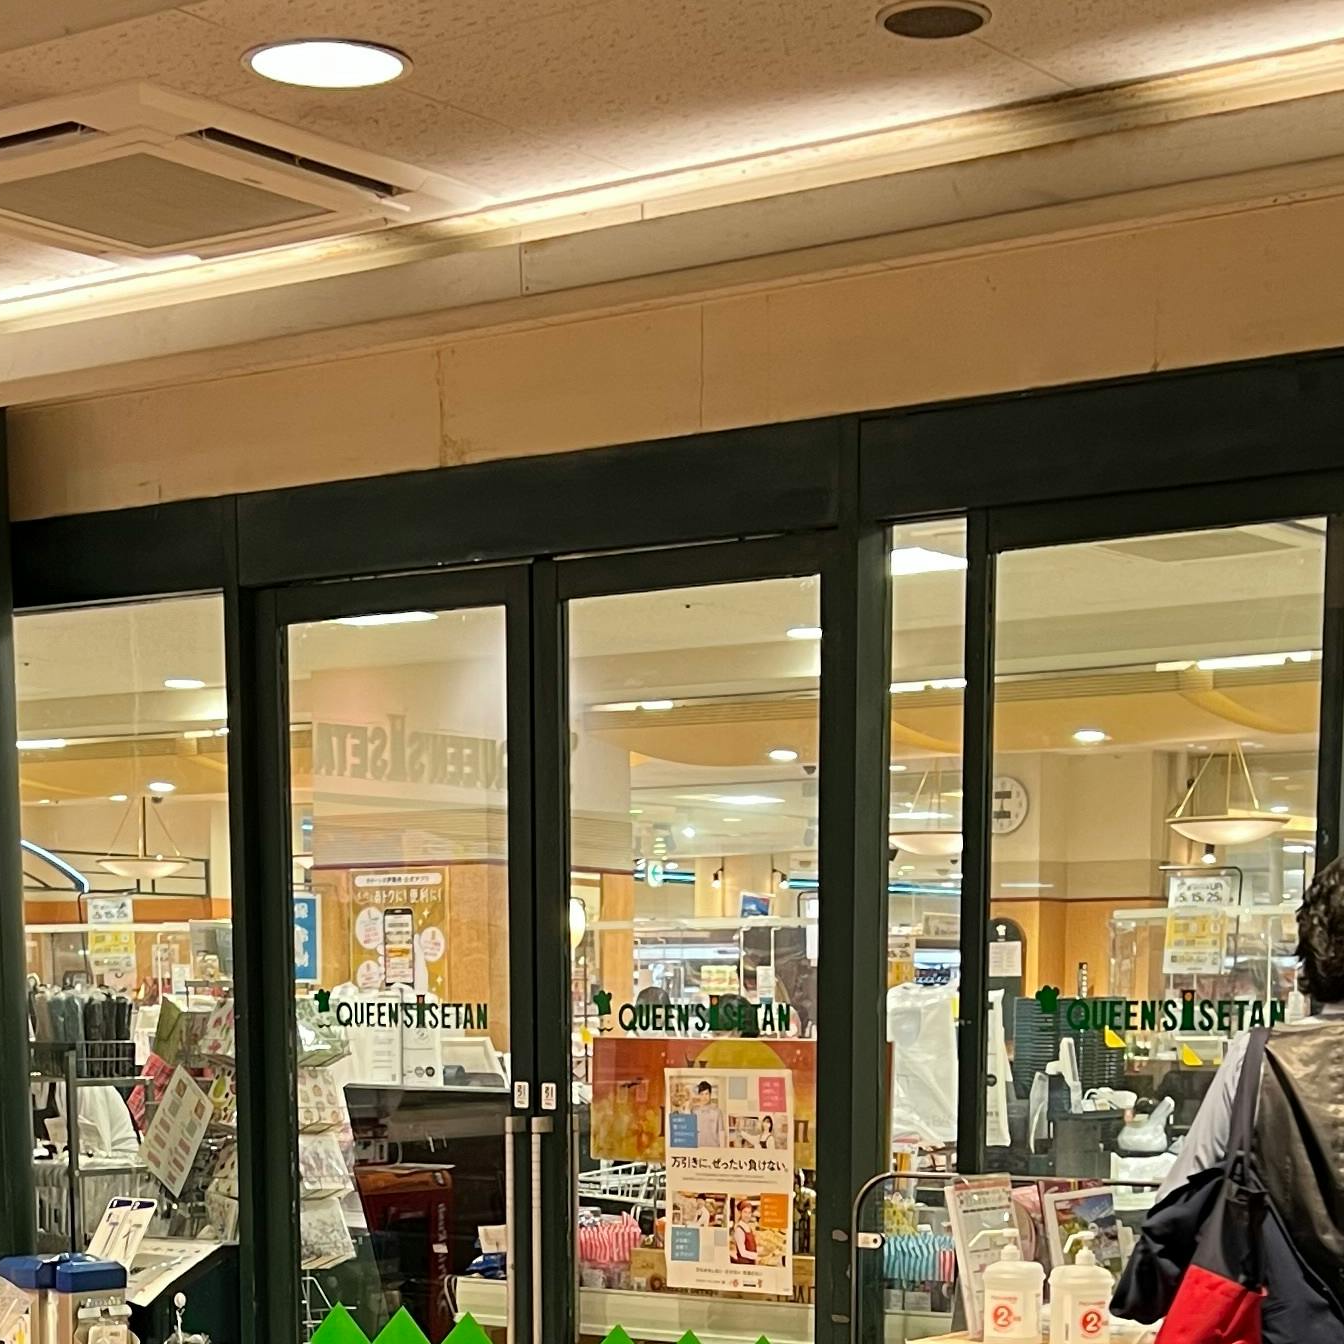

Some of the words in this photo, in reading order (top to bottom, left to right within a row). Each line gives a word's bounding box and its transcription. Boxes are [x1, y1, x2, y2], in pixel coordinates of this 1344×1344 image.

[336, 1001, 414, 1029] QUEEN'S
[414, 995, 488, 1029] ISETAN
[618, 1002, 707, 1032] QUEEN'S
[708, 995, 791, 1032] ISETAN
[1066, 997, 1178, 1032] QUEEN'S
[1180, 989, 1286, 1032] ISETAN
